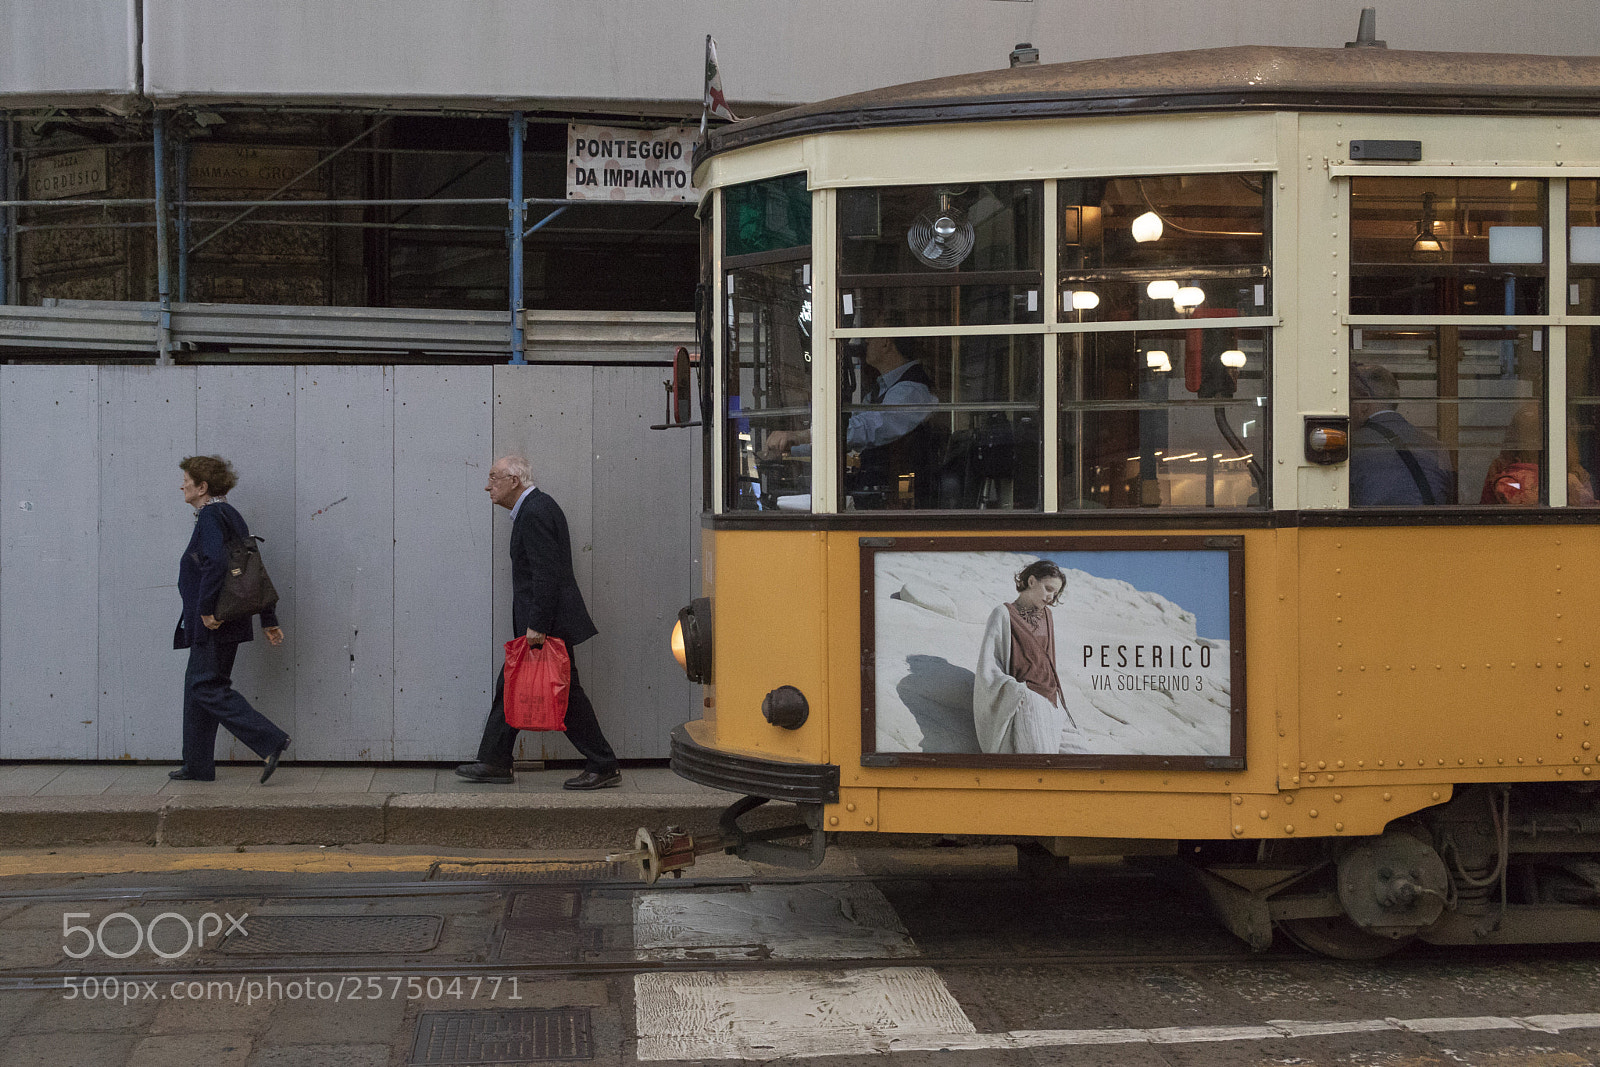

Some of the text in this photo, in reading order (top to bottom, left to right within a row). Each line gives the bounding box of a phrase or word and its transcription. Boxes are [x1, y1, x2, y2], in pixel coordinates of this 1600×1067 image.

[575, 138, 683, 160] PONTEGGIO
[35, 169, 99, 192] CORDUSIO
[188, 166, 249, 178] OMMASO
[575, 167, 687, 188] DA IMPIANTO
[1083, 644, 1211, 668] PESERICO
[1091, 674, 1203, 692] VIA SOLFERINO 3
